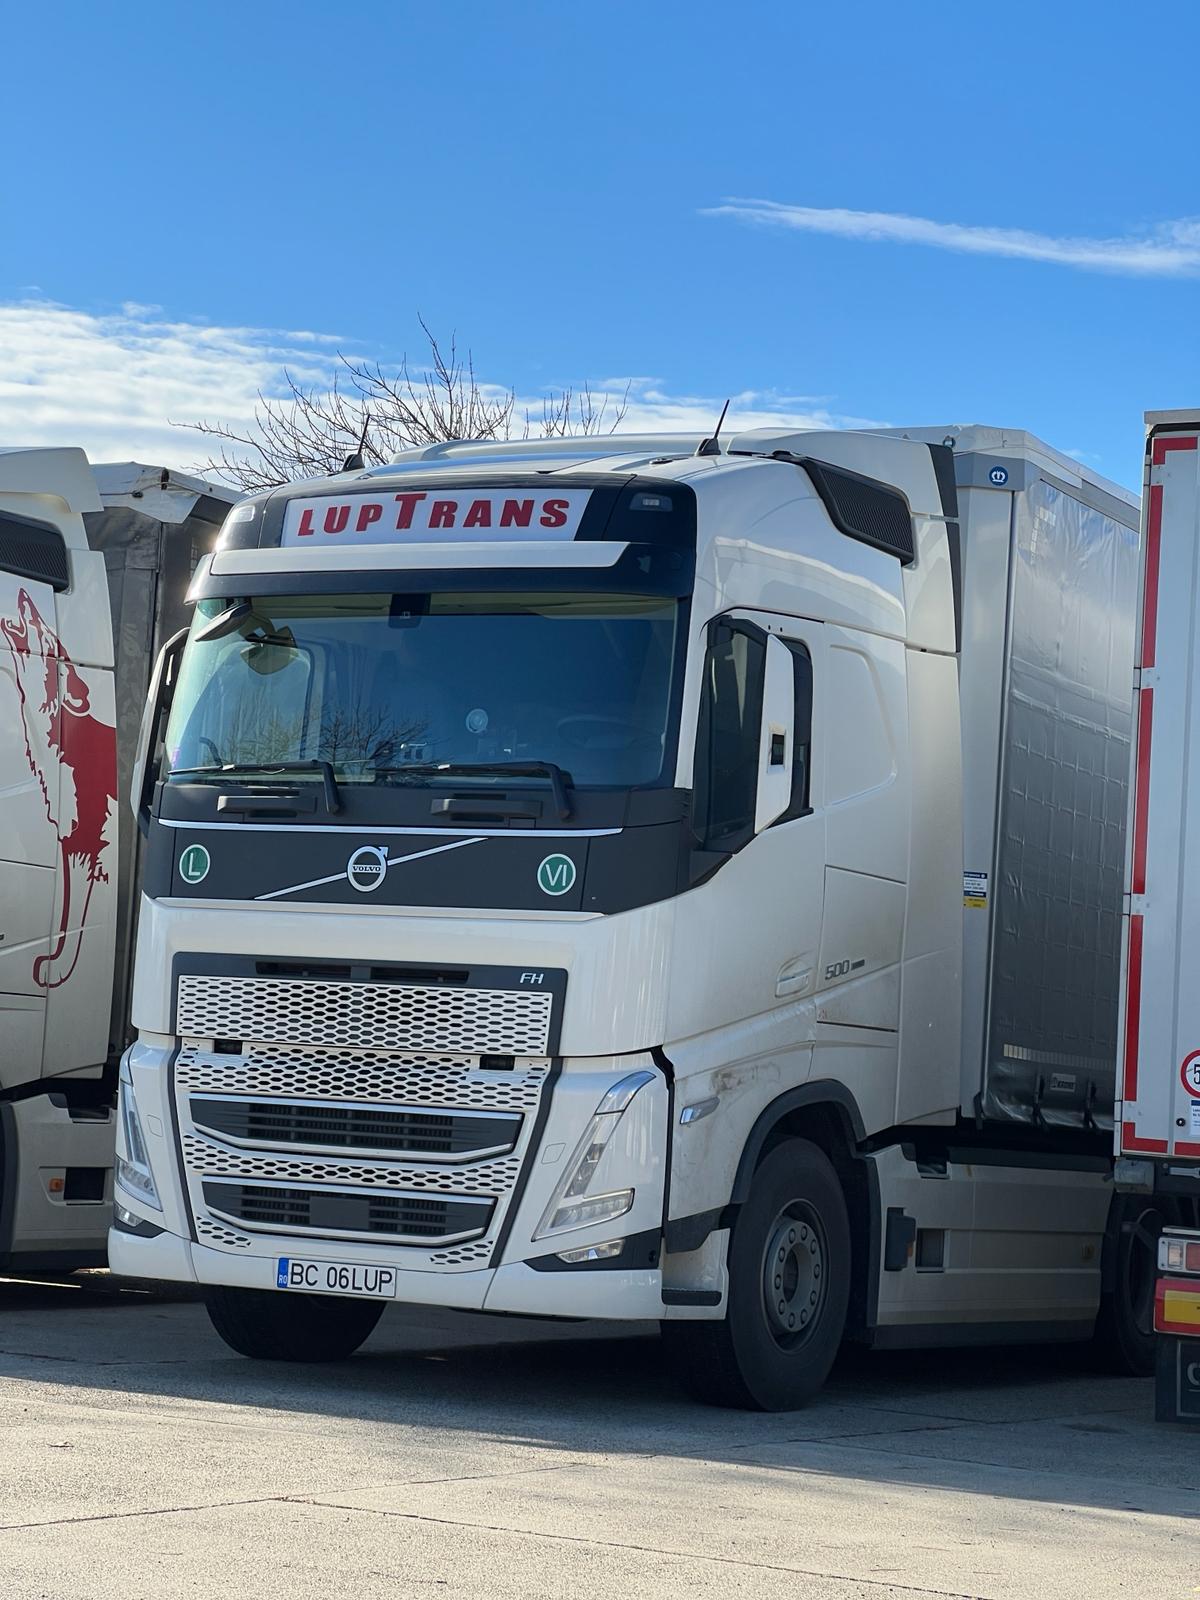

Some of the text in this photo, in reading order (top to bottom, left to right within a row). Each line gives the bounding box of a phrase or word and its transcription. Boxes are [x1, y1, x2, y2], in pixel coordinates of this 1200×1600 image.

[188, 852, 201, 876] L
[545, 864, 567, 887] VI
[519, 972, 545, 984] FH
[825, 959, 850, 980] 500
[278, 1274, 288, 1284] RO
[290, 1263, 319, 1287] BC
